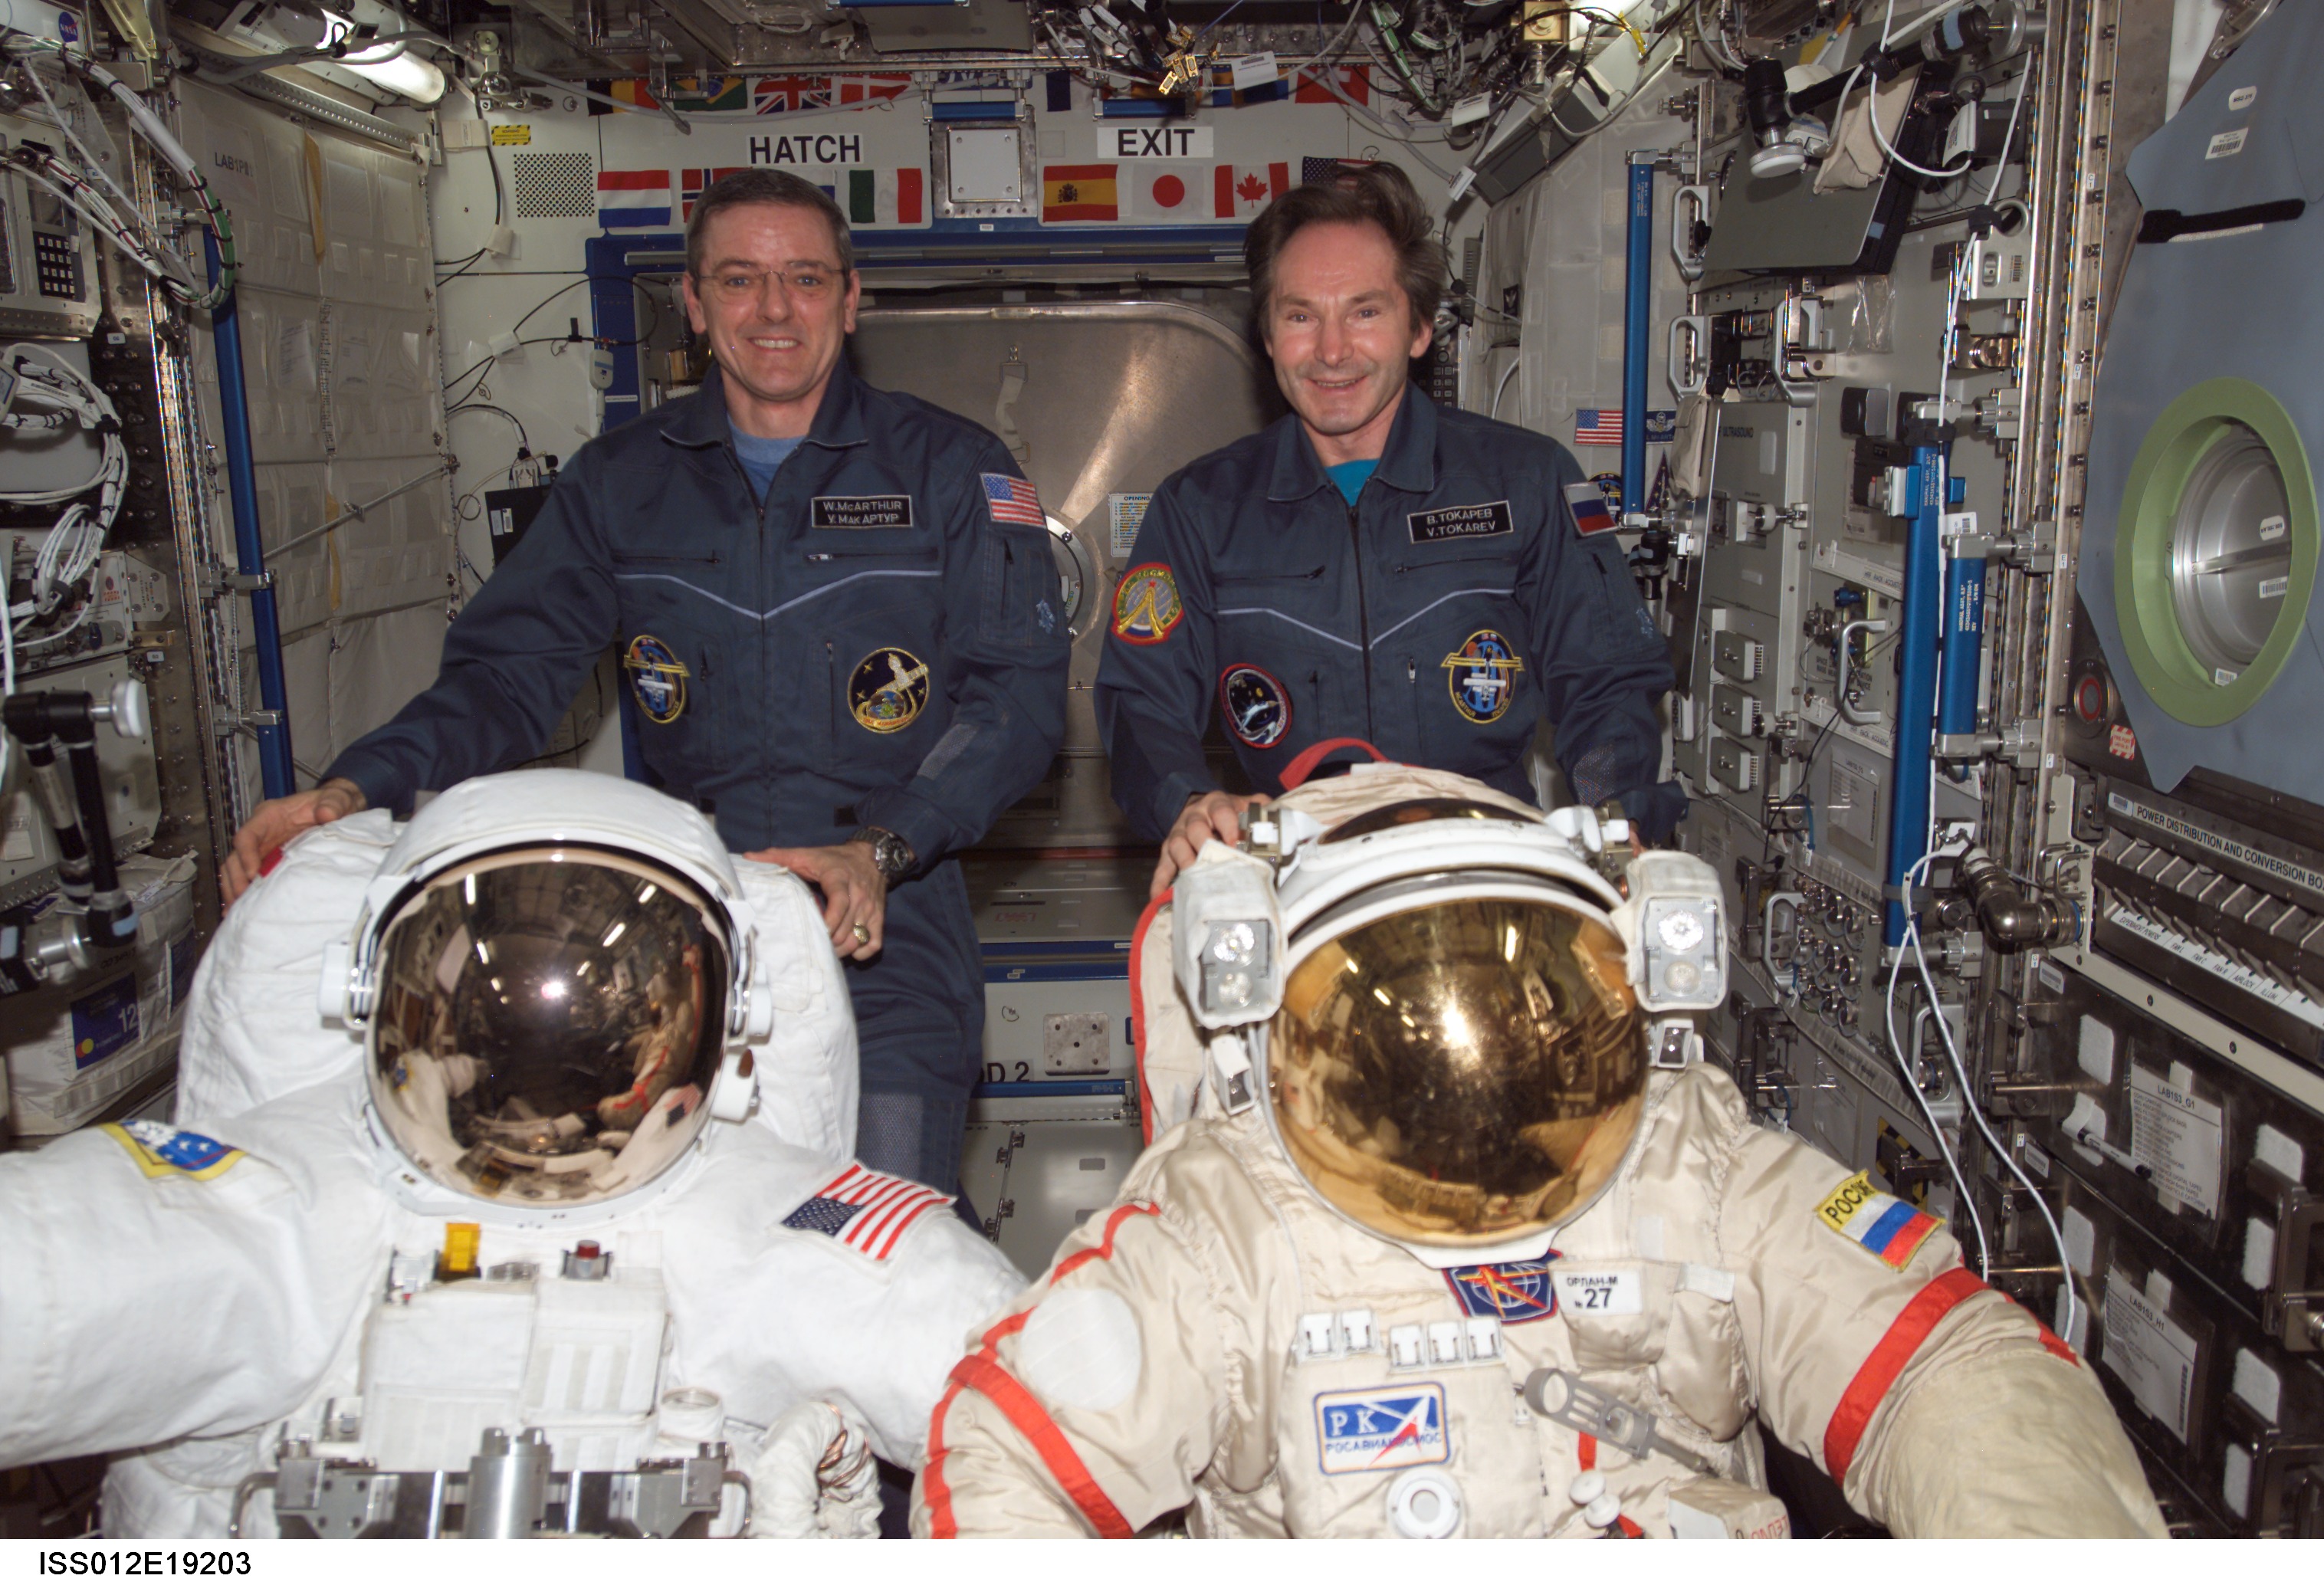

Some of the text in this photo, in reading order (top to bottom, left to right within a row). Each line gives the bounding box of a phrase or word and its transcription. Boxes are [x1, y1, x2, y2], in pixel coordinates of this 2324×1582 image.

[750, 135, 860, 164] HATCH
[1118, 129, 1195, 156] EXIT
[2137, 806, 2324, 890] POWER DISTRIBUTION AND CONVERSION BO
[118, 1003, 138, 1033] 12
[1015, 1062, 1030, 1082] 2
[2158, 1085, 2196, 1109] LAB1S3_G1
[1584, 1288, 1612, 1308] 27
[2129, 1294, 2165, 1331] LAB1S3_H1
